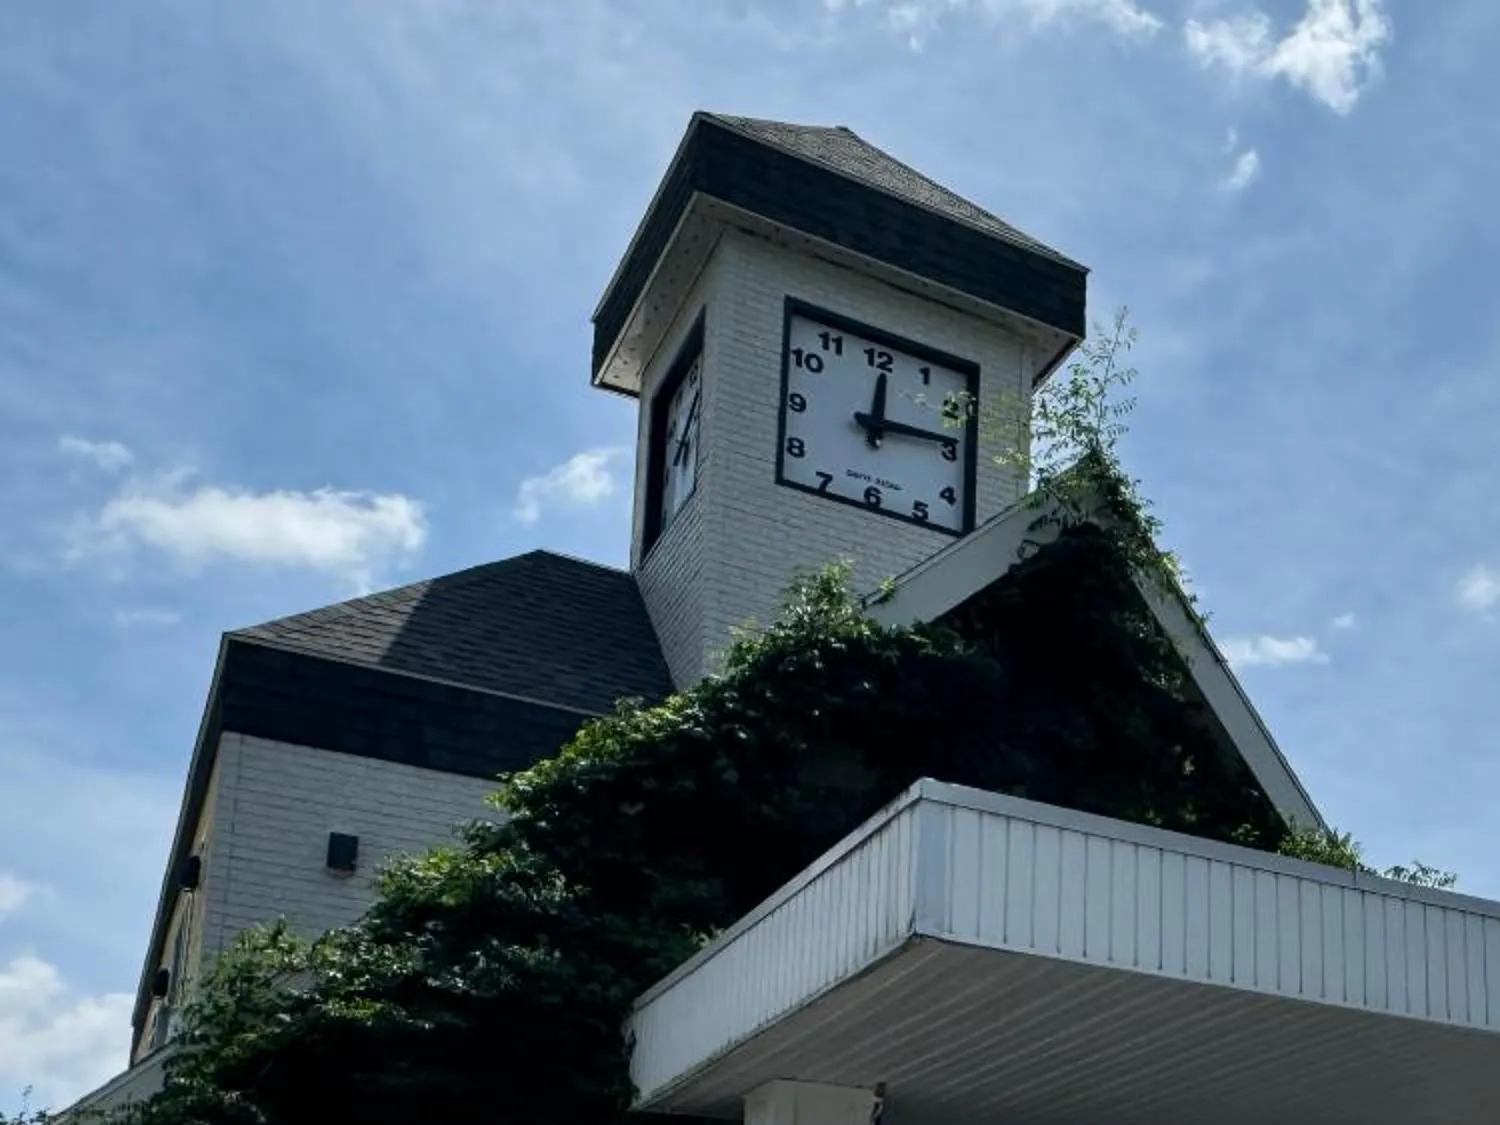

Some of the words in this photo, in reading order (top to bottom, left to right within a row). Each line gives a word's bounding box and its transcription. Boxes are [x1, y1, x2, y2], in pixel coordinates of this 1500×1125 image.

[818, 332, 843, 356] 11
[791, 347, 824, 374] 10
[863, 347, 895, 374] 12
[918, 367, 931, 386] 1
[788, 393, 807, 414] 9
[942, 399, 959, 420] 2
[786, 437, 806, 459] 8
[941, 441, 957, 462] 3
[815, 471, 834, 492] 7
[863, 485, 883, 508] 6
[939, 486, 957, 506] 4
[911, 501, 929, 522] 5
